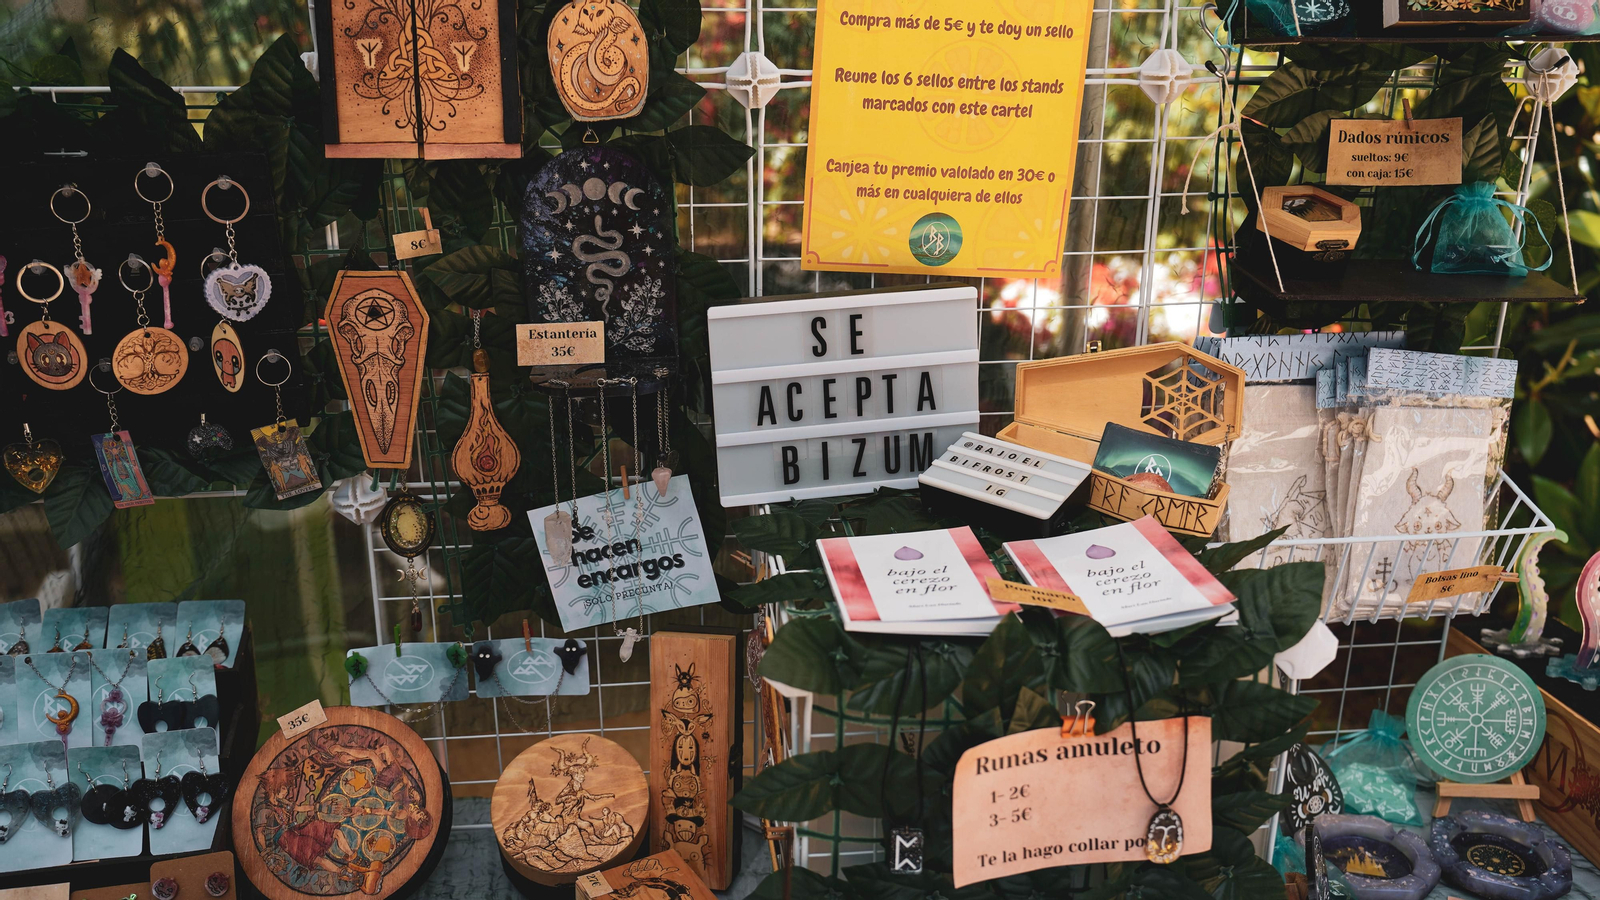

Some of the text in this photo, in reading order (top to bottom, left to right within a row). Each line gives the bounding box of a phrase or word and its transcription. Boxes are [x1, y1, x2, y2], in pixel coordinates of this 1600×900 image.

[840, 11, 1073, 40] Compra más de 5€ y te doy un sello
[834, 67, 1064, 94] Reune los 6 sellos entre los stands
[862, 96, 1033, 118] marcados con este cartel
[1338, 129, 1450, 144] Dados rúnicos
[1351, 152, 1409, 162] sueltos: 9€
[826, 159, 1056, 182] Canjea tu premio valolado en 30€ o
[1346, 168, 1414, 180] con caja: 15€
[856, 184, 1023, 205] más en cualquiera de ellos
[411, 239, 427, 250] 8€
[528, 328, 597, 340] Estantería
[811, 314, 864, 357] SE
[551, 346, 576, 357] 35€
[757, 371, 937, 426] ACEPTA
[781, 432, 933, 485] BIZUM
[950, 455, 1028, 482] BIFROST
[986, 485, 1005, 496] IG
[571, 538, 642, 567] hacen
[577, 553, 685, 588] encargos
[887, 565, 948, 578] bajo el
[1086, 560, 1145, 579] bajo el
[1425, 570, 1479, 584] Bolsas lino
[893, 576, 950, 585] cerezo
[1096, 572, 1151, 587] cerezo
[1102, 579, 1162, 597] en flor
[896, 583, 957, 595] en flor
[288, 713, 310, 730] 35€
[975, 737, 1161, 775] Runas amuleto
[1009, 784, 1031, 800] 2€
[1011, 807, 1032, 823] 5€
[978, 837, 1147, 868] Te la hago collar po
